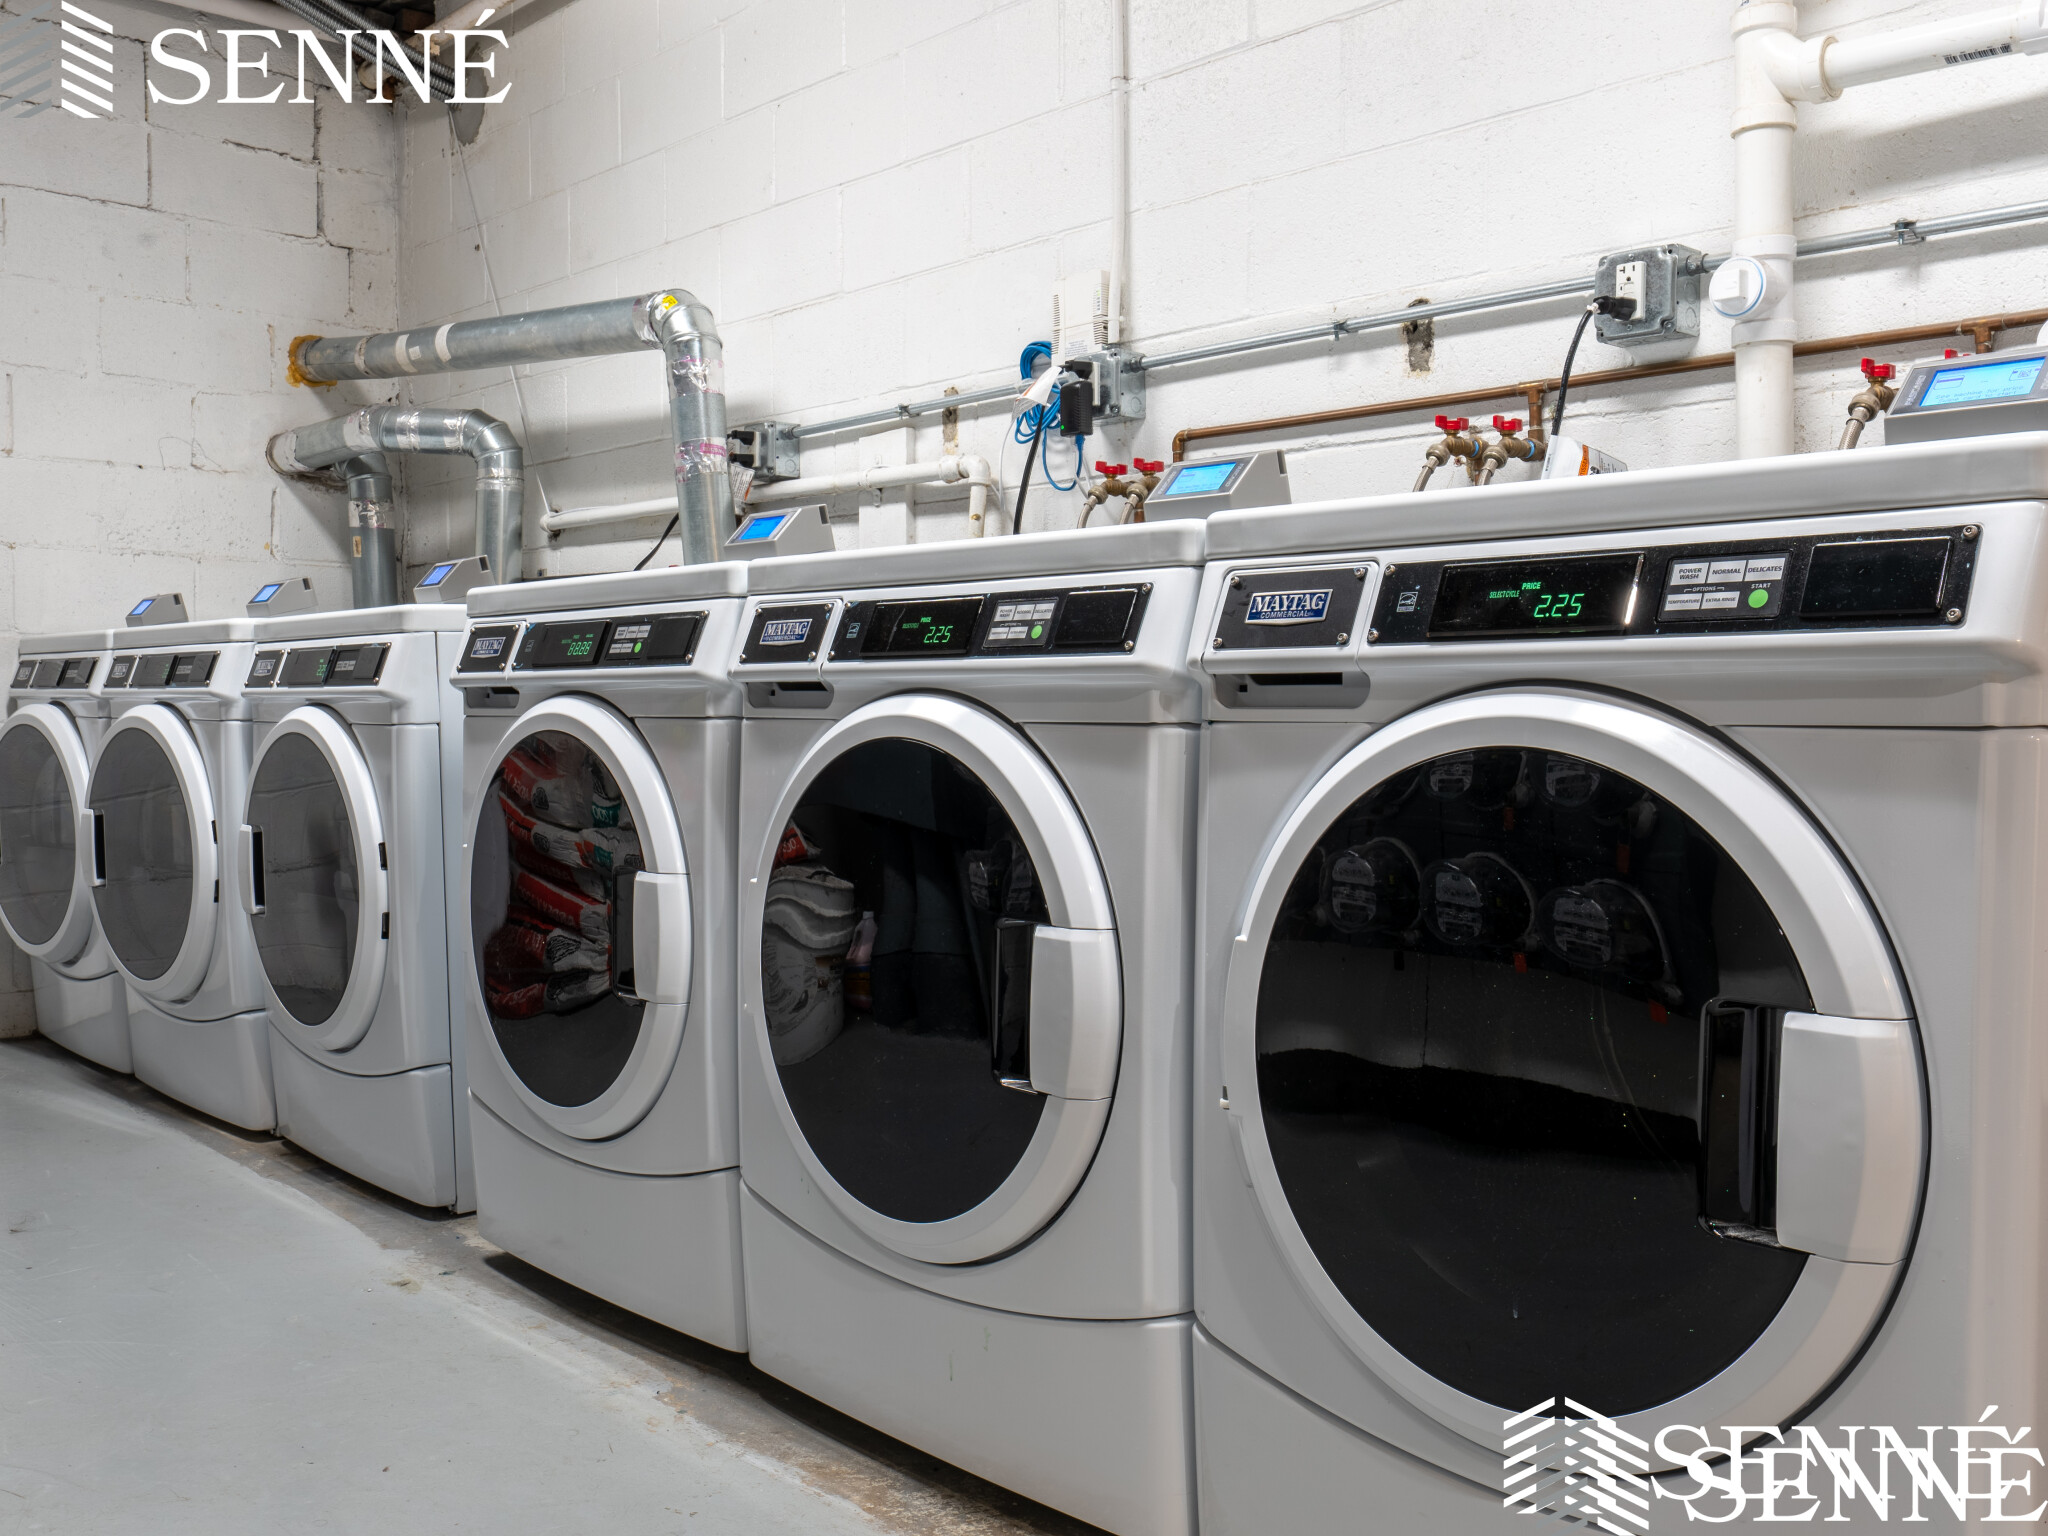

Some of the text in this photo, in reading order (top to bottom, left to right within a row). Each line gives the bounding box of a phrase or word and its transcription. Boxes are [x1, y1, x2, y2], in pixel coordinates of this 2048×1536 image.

[1747, 565, 1783, 573] DELICATES
[1521, 581, 1542, 590] PRICE
[1251, 593, 1325, 613] MAYTAG
[1533, 593, 1585, 618] 2.25
[1260, 610, 1309, 619] COMMERCIAL
[765, 622, 807, 636] MAYTAG
[923, 625, 954, 643] 2.25
